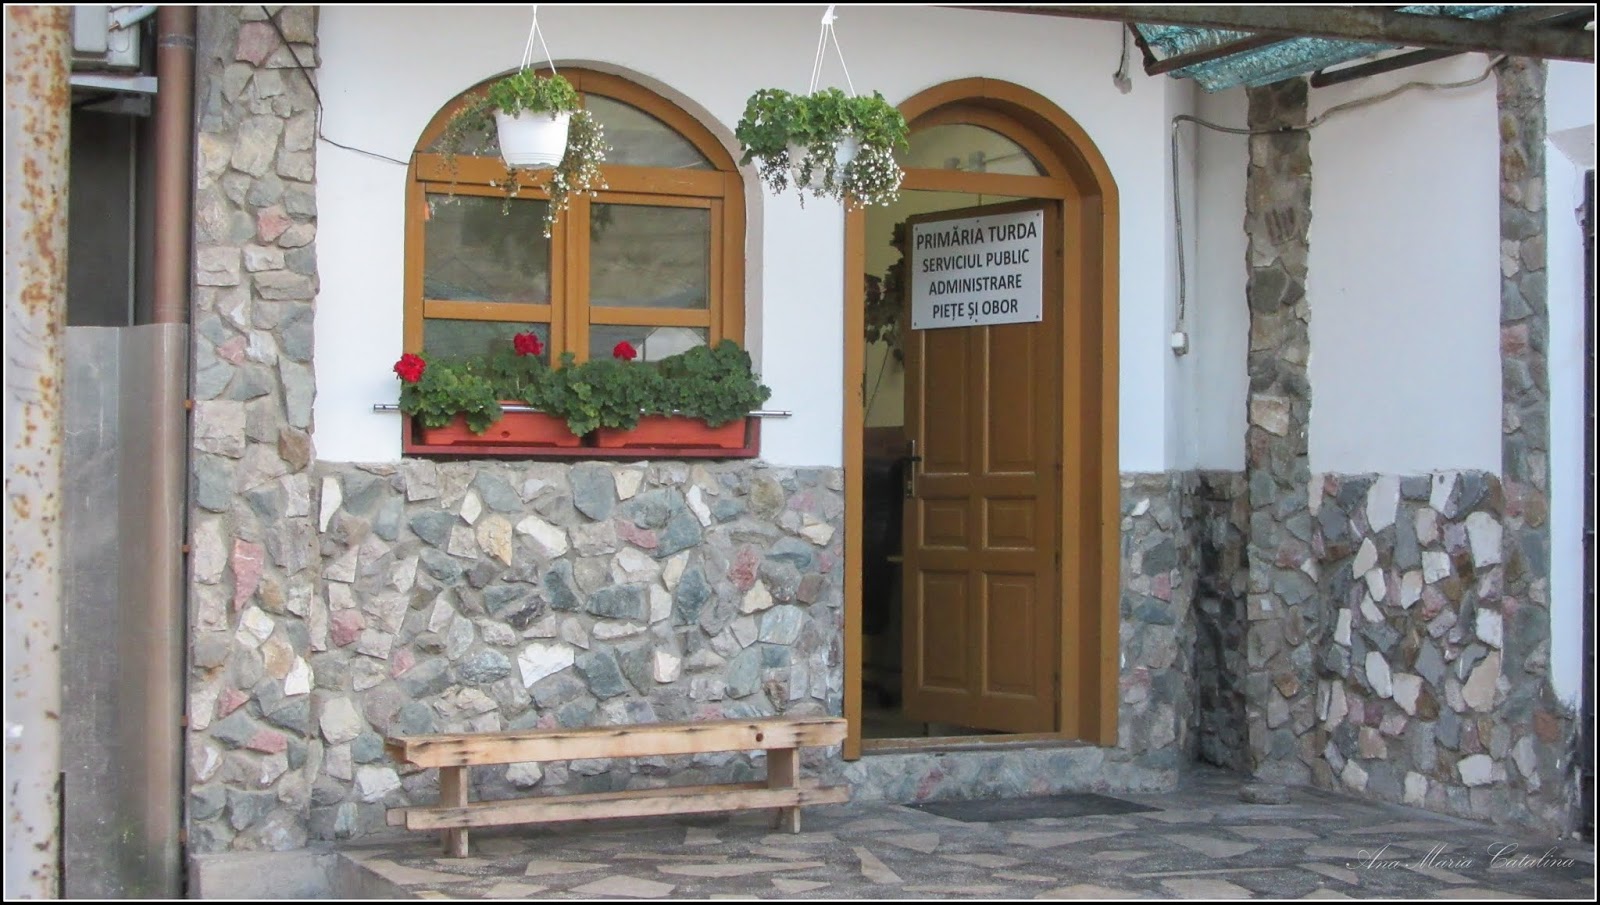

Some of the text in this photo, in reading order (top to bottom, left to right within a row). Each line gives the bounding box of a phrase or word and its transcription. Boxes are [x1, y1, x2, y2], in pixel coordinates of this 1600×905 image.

[917, 222, 1037, 250] PRIMĂRIA TURDA
[923, 249, 1030, 273] SERVICIUL PUBLIC
[928, 274, 1022, 296] ADMINISTRARE
[932, 302, 964, 321] PIEȚE
[982, 299, 1018, 315] OBOR
